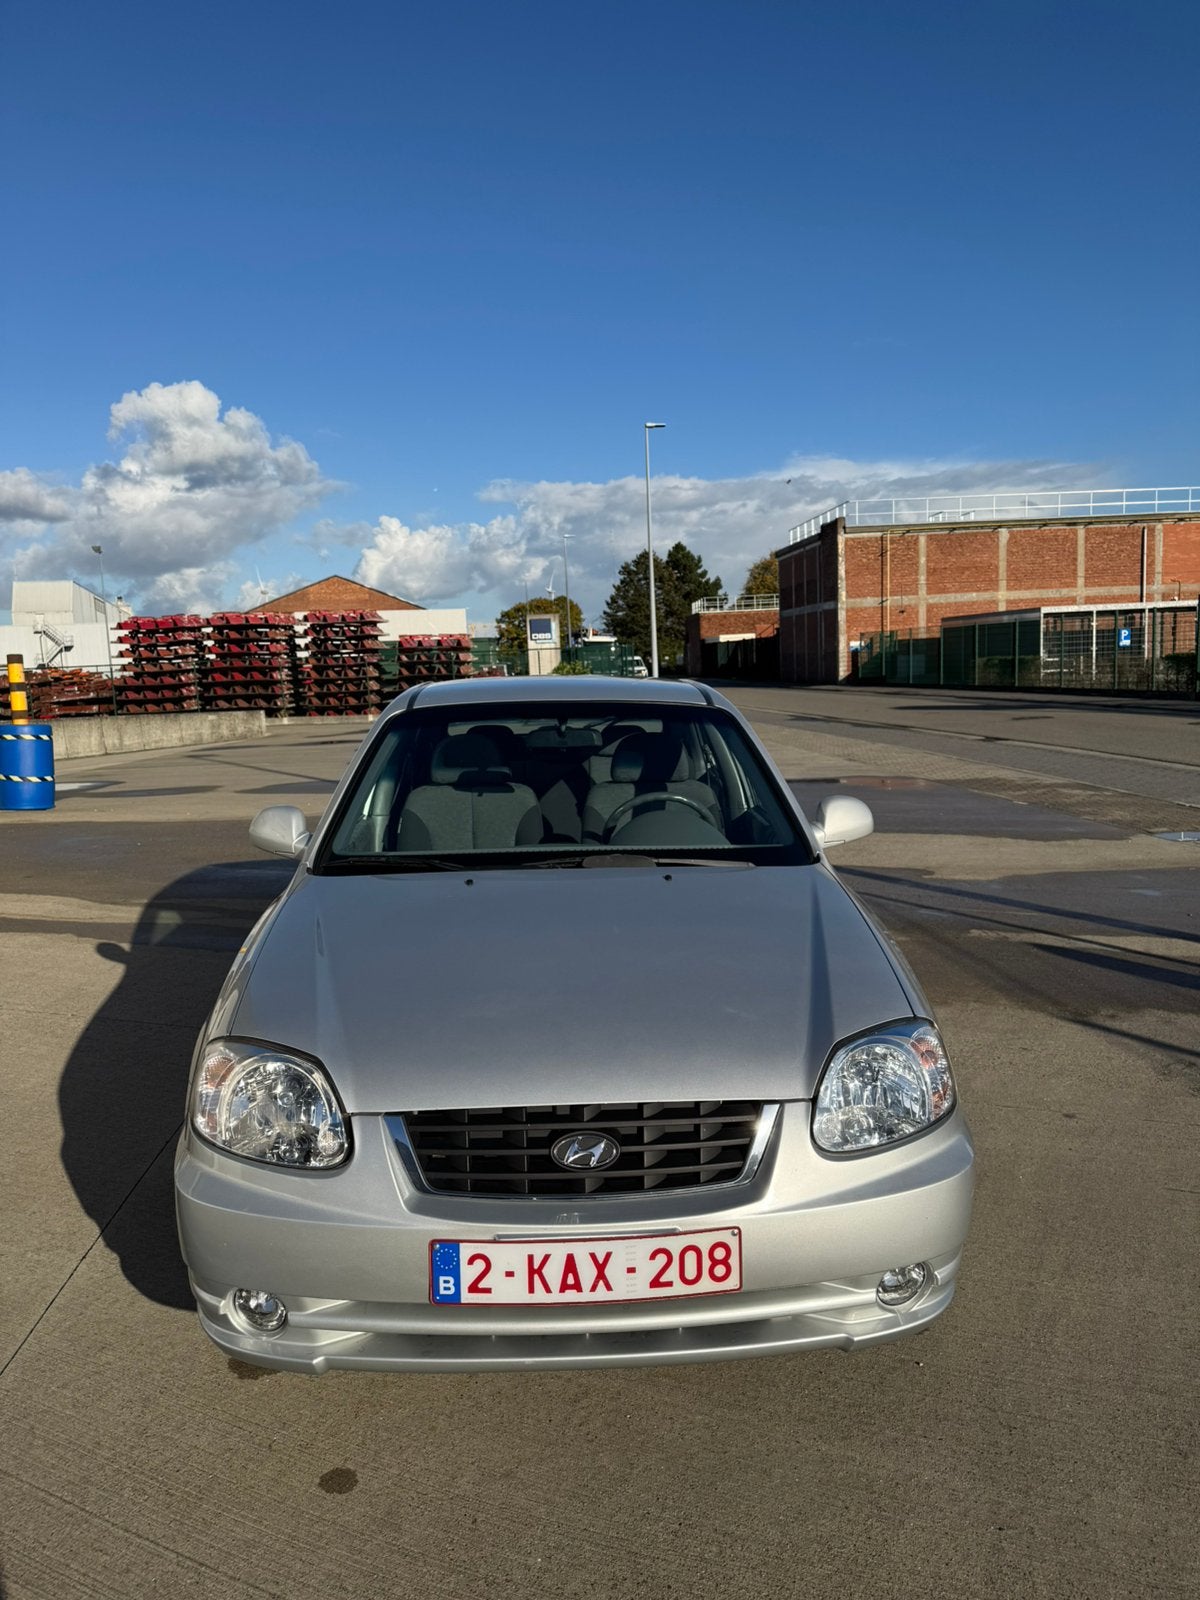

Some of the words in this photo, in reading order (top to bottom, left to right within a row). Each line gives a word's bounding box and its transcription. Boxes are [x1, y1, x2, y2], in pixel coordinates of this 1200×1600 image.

[1121, 629, 1129, 641] P
[467, 1243, 733, 1295] 2-KAX-208
[439, 1276, 456, 1295] B
